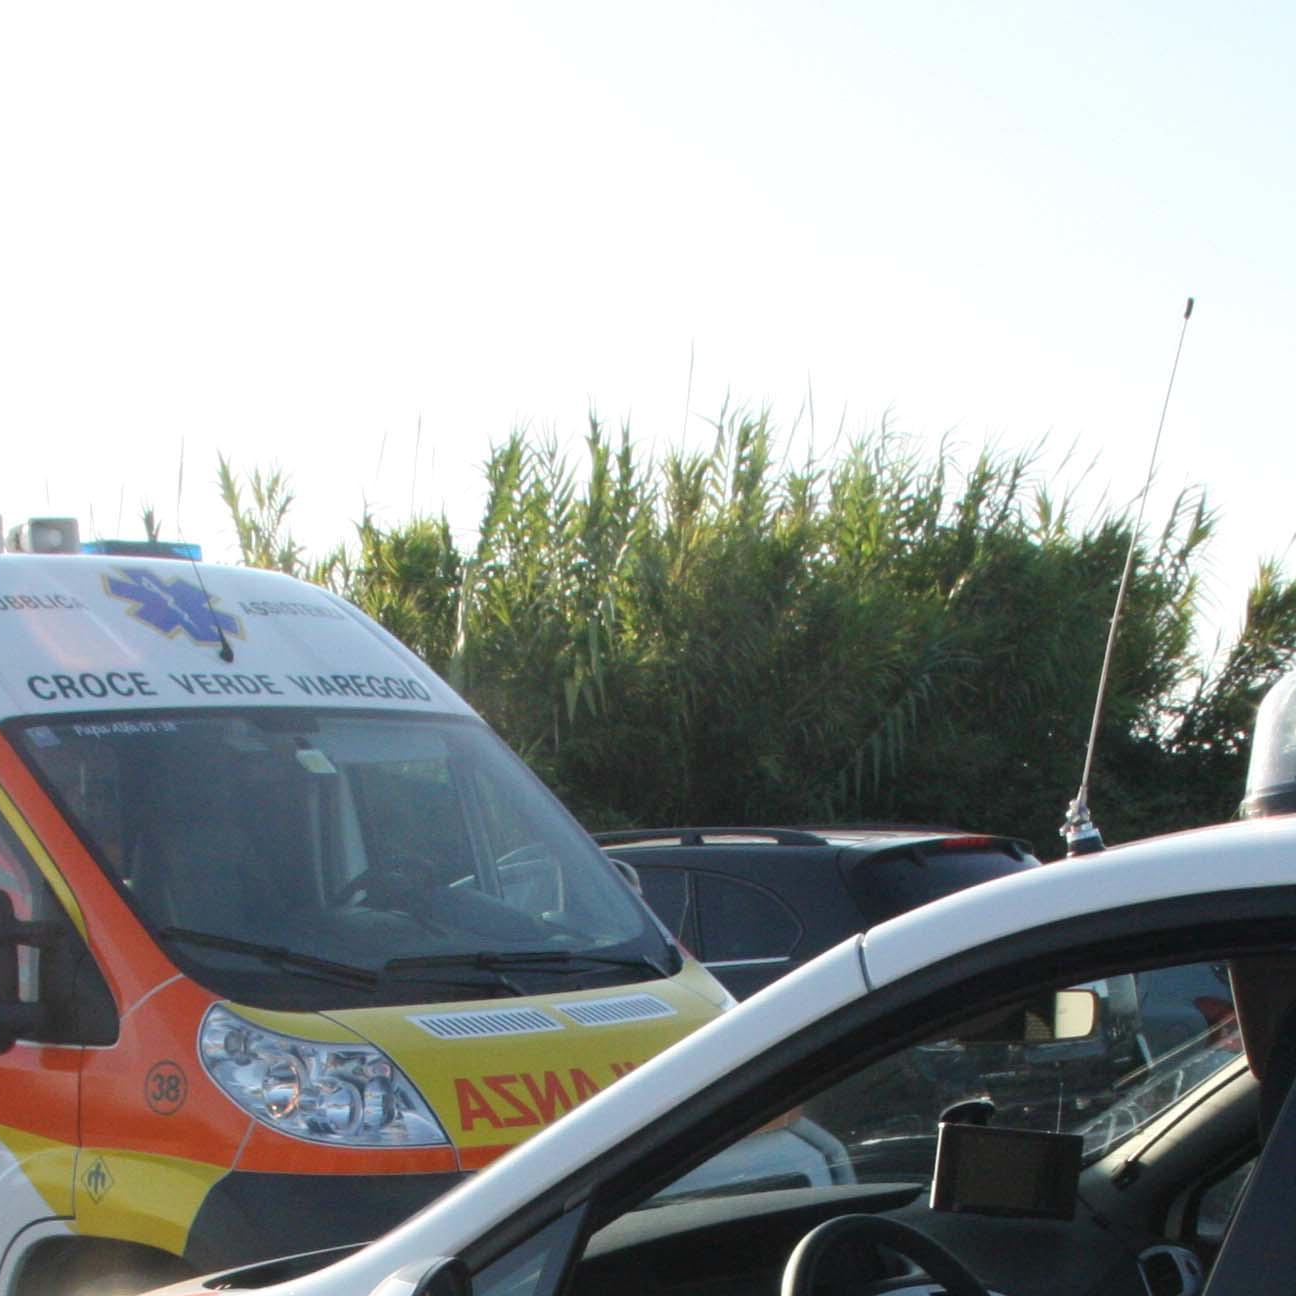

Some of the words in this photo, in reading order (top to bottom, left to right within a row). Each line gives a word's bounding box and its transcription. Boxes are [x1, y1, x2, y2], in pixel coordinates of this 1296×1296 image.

[27, 671, 158, 701] CROCE
[172, 673, 282, 698] VERDE
[286, 674, 432, 702] VIAREGGIO
[151, 1073, 181, 1102] 38
